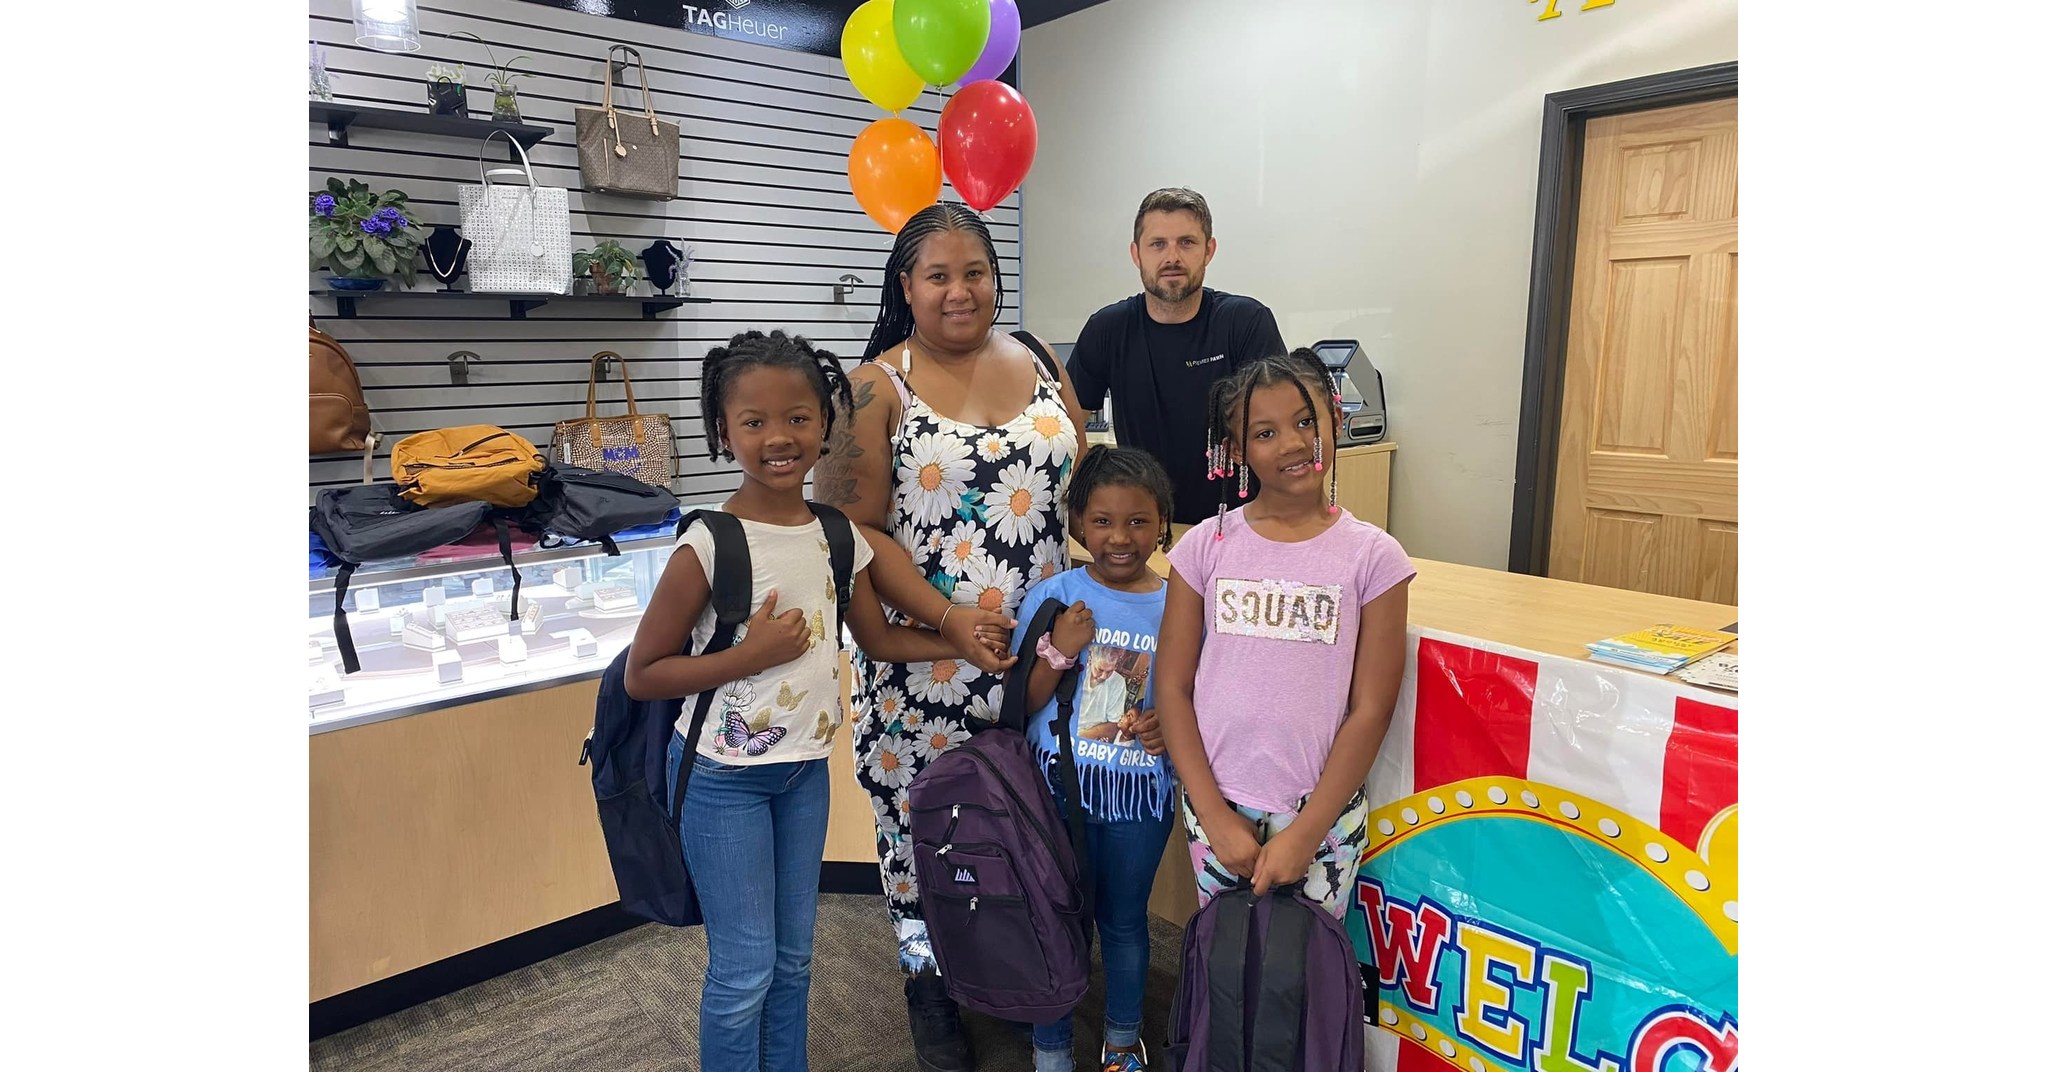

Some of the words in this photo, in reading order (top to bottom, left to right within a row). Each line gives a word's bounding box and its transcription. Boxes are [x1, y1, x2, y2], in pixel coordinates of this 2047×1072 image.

[1221, 590, 1335, 631] SQUAD
[1077, 740, 1118, 764] BABY
[1120, 748, 1157, 767] GIRLS
